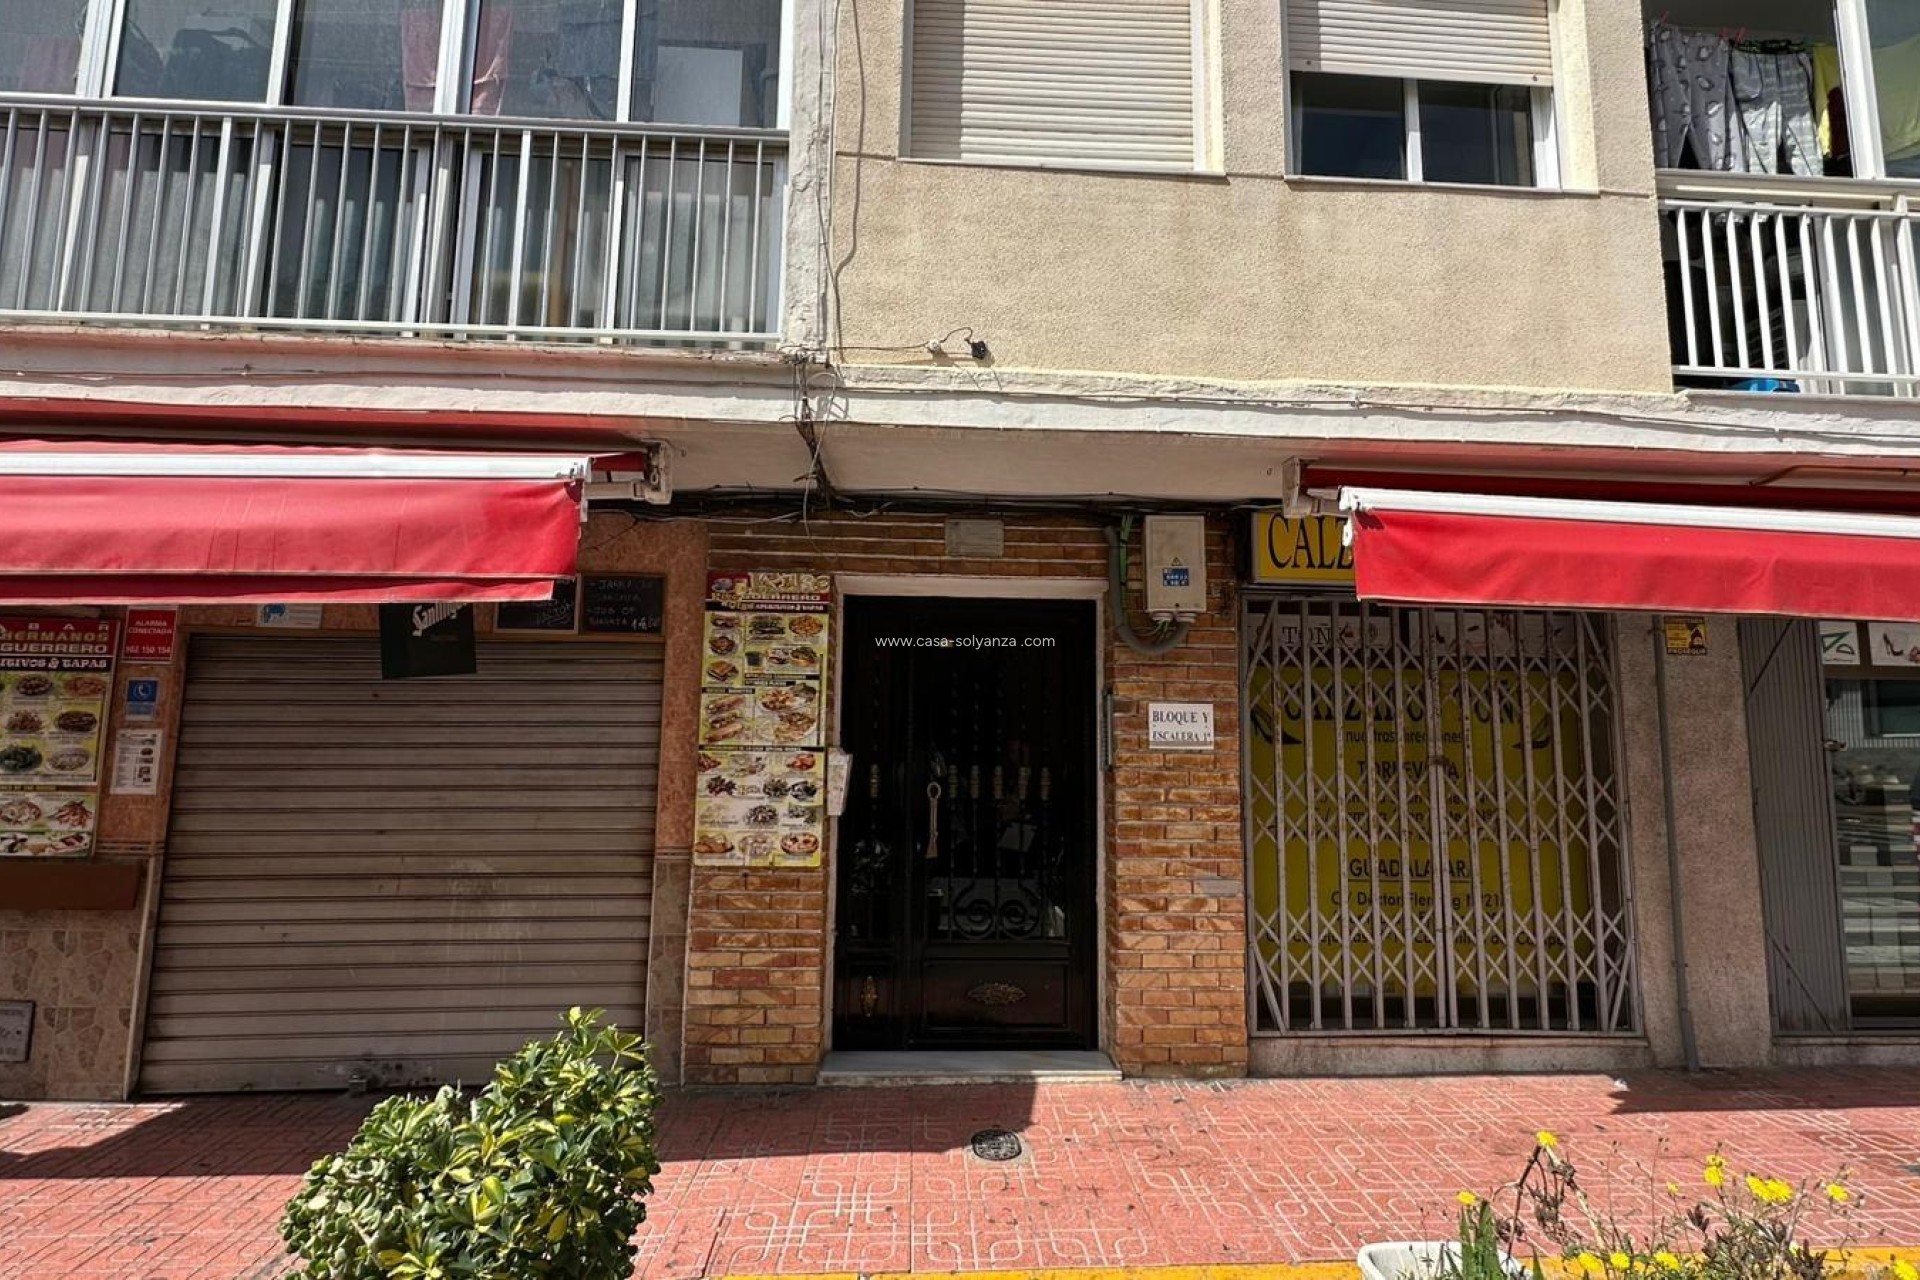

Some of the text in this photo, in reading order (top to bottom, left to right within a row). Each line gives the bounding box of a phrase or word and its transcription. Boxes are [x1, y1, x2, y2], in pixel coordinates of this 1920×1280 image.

[0, 642, 108, 654] GUERRERO
[1152, 711, 1198, 725] BLOQUE
[1350, 857, 1478, 877] GUADLAAR
